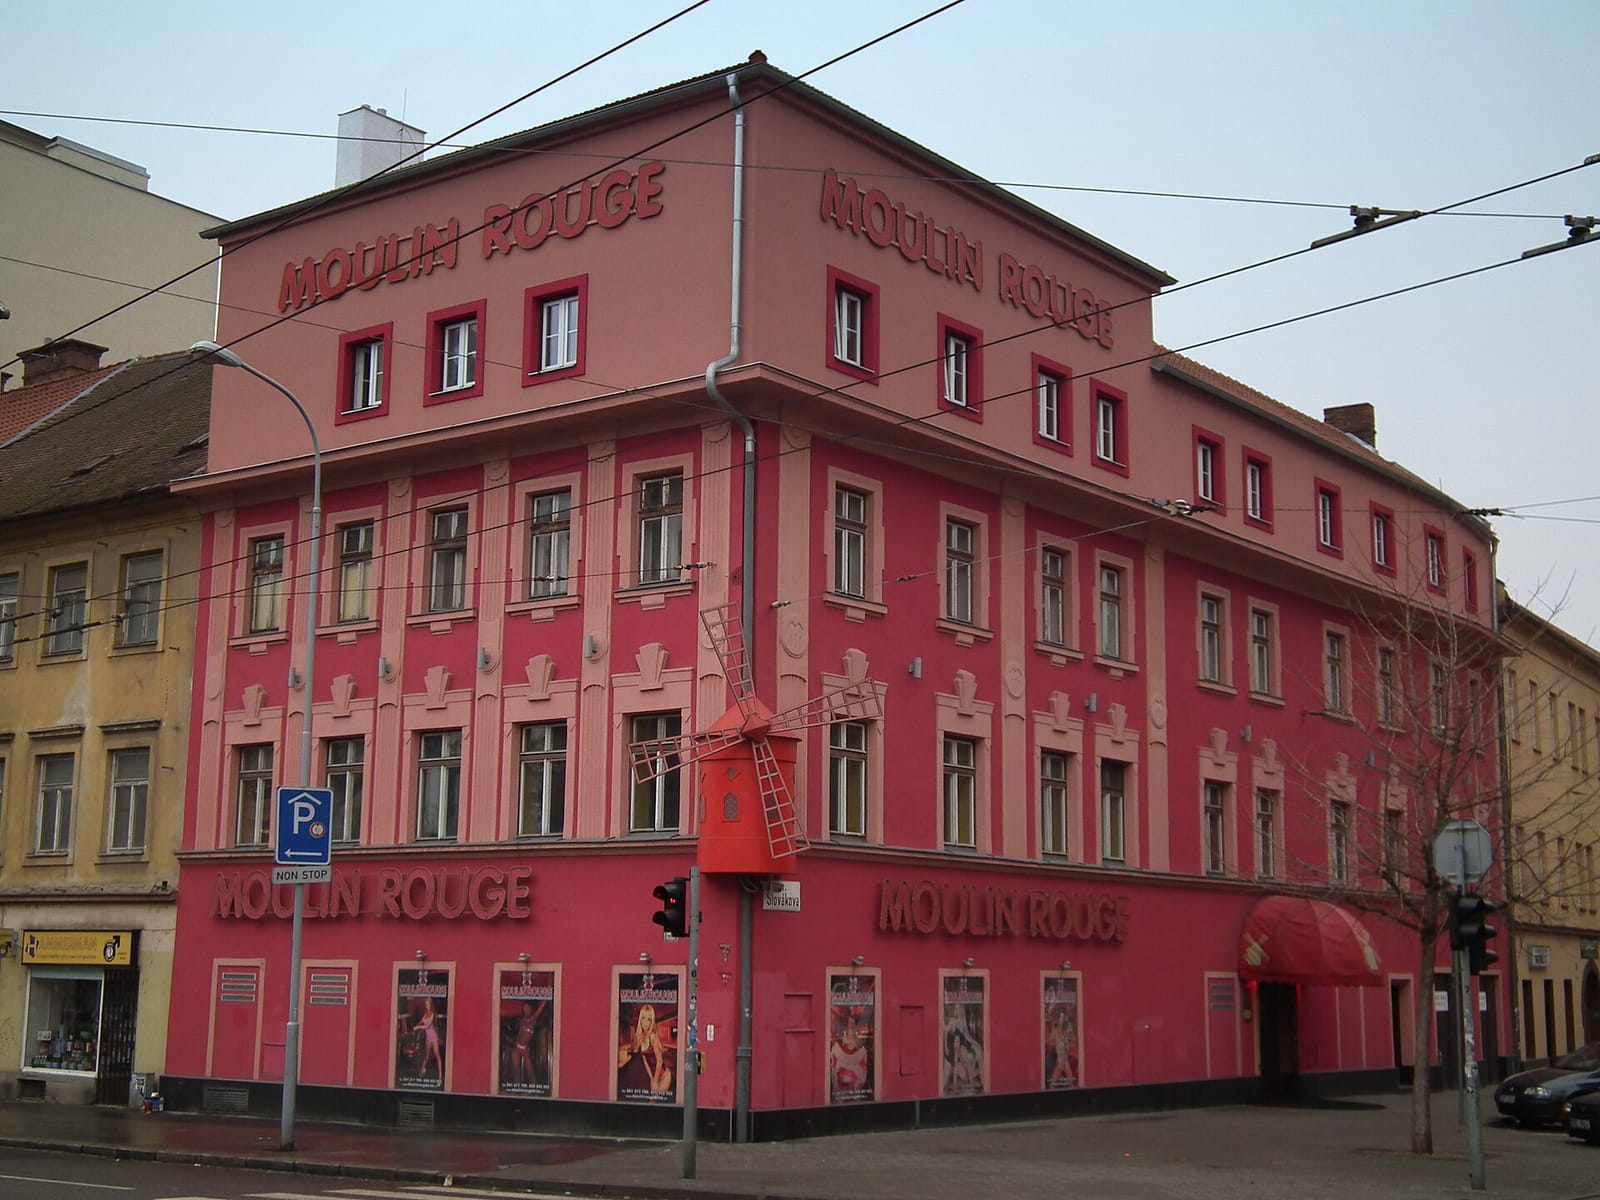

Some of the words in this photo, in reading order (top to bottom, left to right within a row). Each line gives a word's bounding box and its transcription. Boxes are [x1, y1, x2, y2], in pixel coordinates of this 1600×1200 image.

[278, 217, 459, 313] MOULIN
[482, 161, 665, 259] ROUGE
[821, 168, 983, 293] MOULIN
[998, 252, 1114, 350] ROUGE
[293, 801, 315, 834] P
[276, 871, 298, 880] NON
[302, 869, 327, 880] STOP
[376, 864, 533, 920] ROUGE
[879, 879, 1018, 935] MOULIN
[1028, 890, 1128, 941] ROUGE
